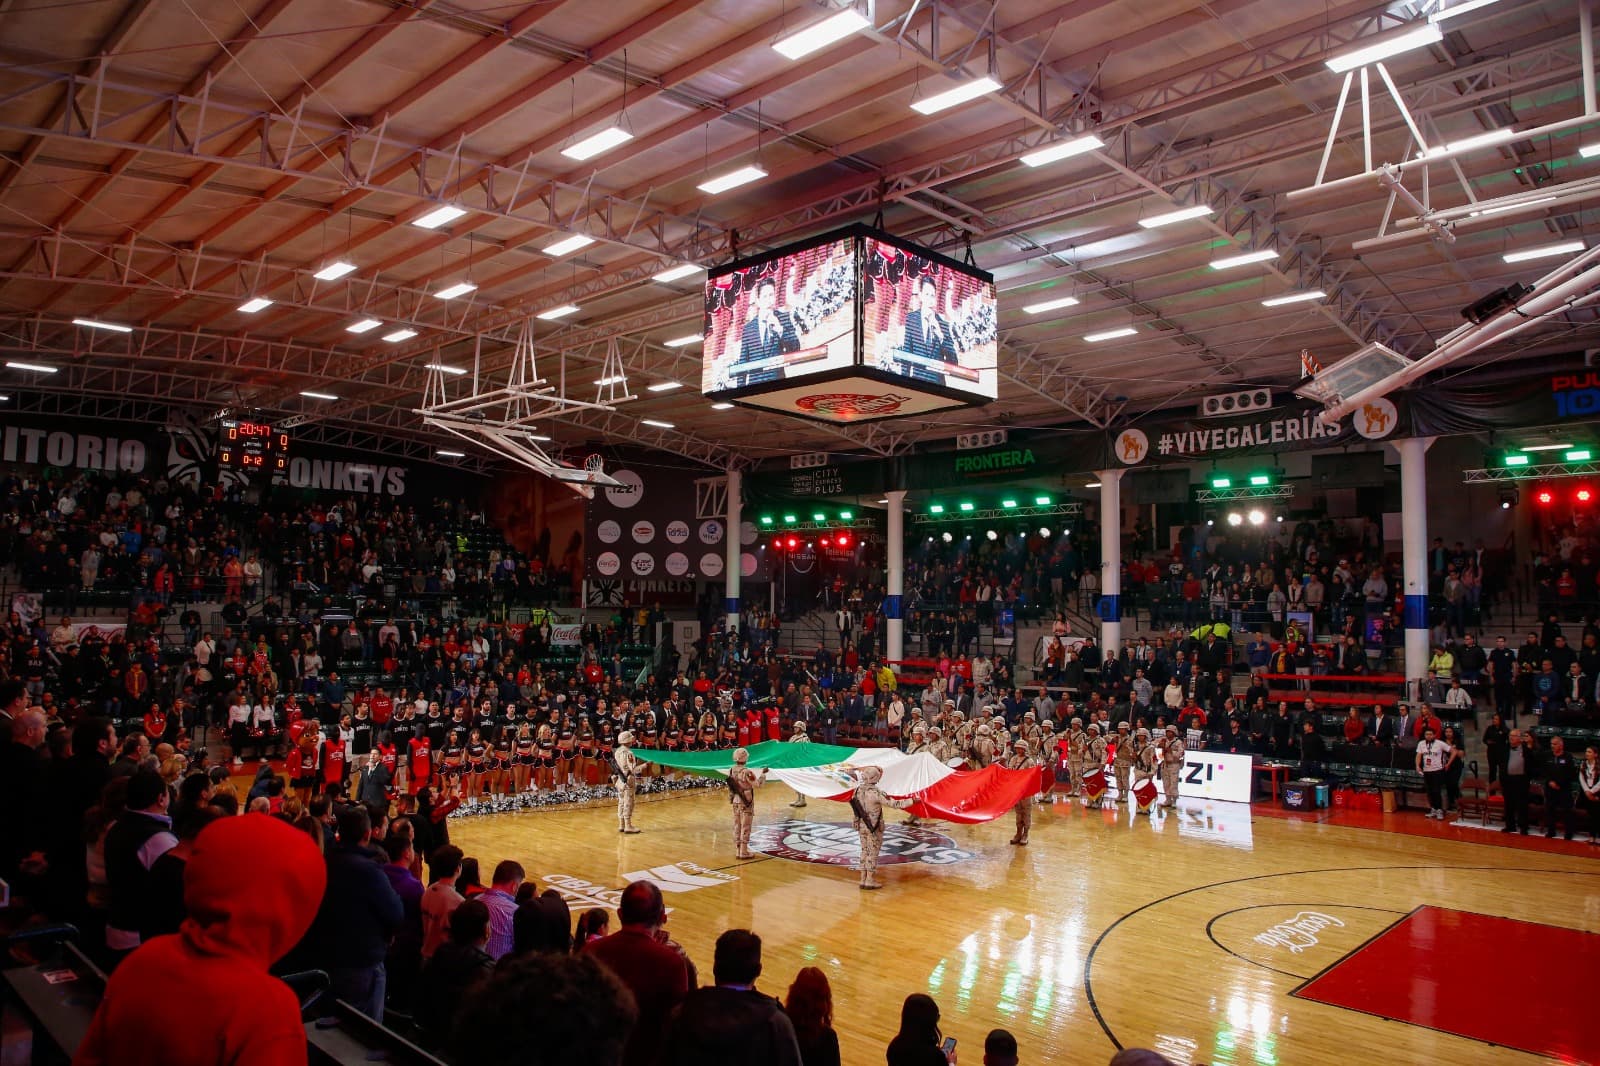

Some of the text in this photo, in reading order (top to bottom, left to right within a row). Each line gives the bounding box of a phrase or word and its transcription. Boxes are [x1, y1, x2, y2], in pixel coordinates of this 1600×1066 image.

[229, 428, 237, 440] 0
[239, 423, 270, 438] 20:47
[1158, 409, 1342, 456] #VIVEGALERÍAS
[280, 434, 288, 446] 0
[0, 425, 146, 474] ITORIO
[223, 453, 229, 462] 0
[278, 459, 284, 468] 0
[955, 448, 1036, 472] FRONTERA
[815, 468, 839, 478] CITY
[815, 484, 842, 495] PLUS
